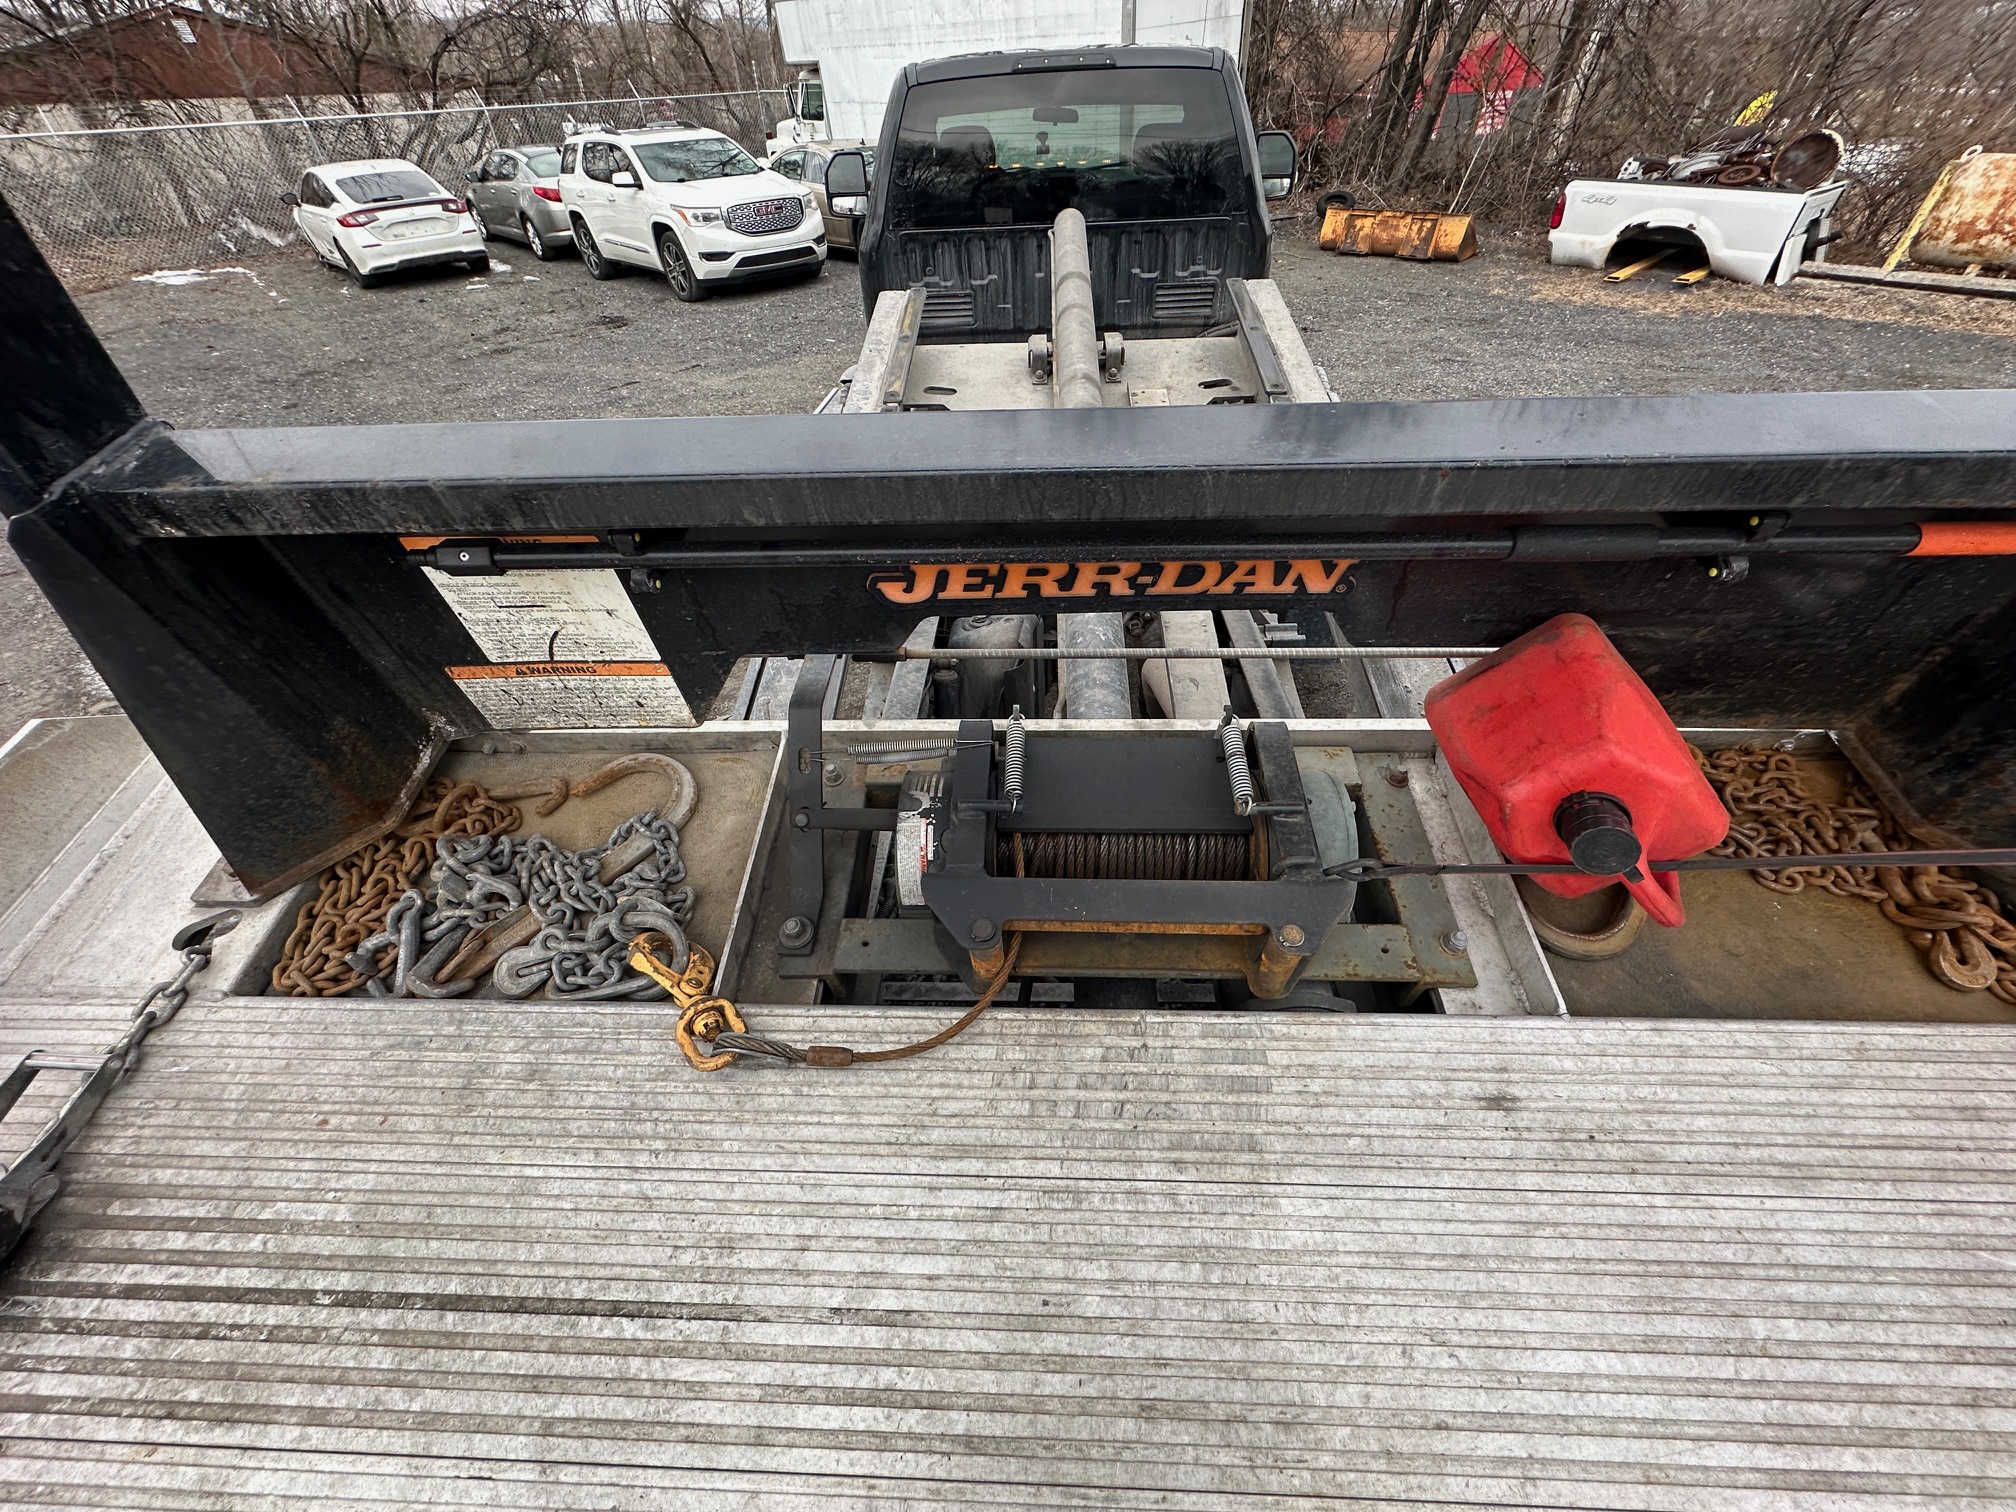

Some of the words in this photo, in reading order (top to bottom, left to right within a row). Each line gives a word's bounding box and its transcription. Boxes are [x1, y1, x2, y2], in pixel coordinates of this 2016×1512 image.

[755, 205, 783, 216] GMC
[875, 559, 1360, 604] JERR-DAN
[527, 666, 597, 675] WARNING
